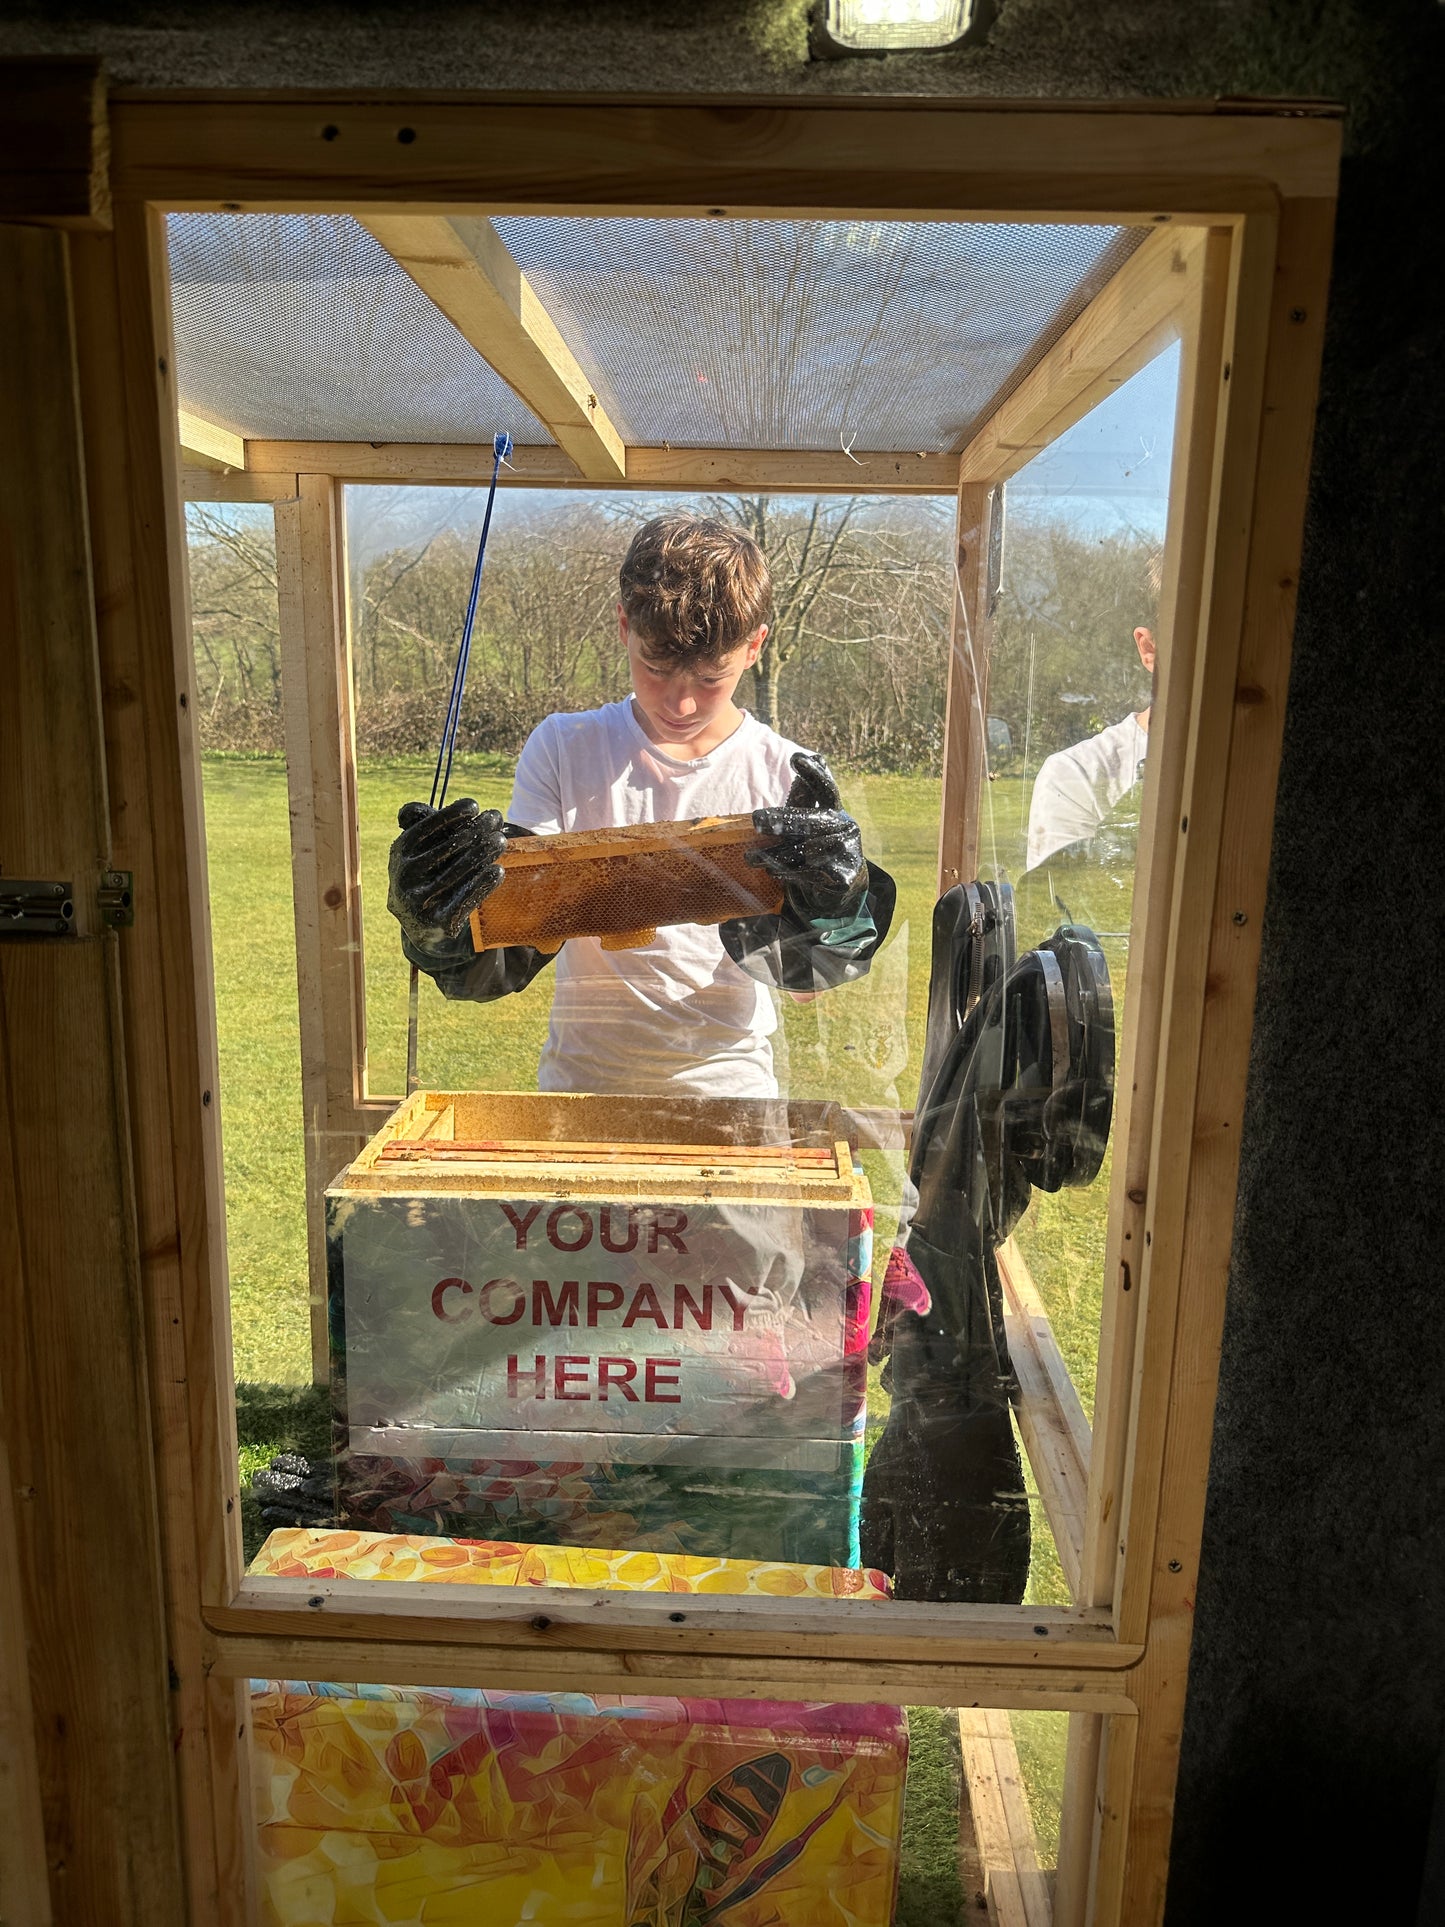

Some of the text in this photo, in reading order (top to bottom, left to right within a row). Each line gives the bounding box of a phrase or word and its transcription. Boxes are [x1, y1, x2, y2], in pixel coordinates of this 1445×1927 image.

[501, 1204, 690, 1254] YOUR
[431, 1277, 759, 1331] COMPANY
[507, 1355, 682, 1403] HERE
